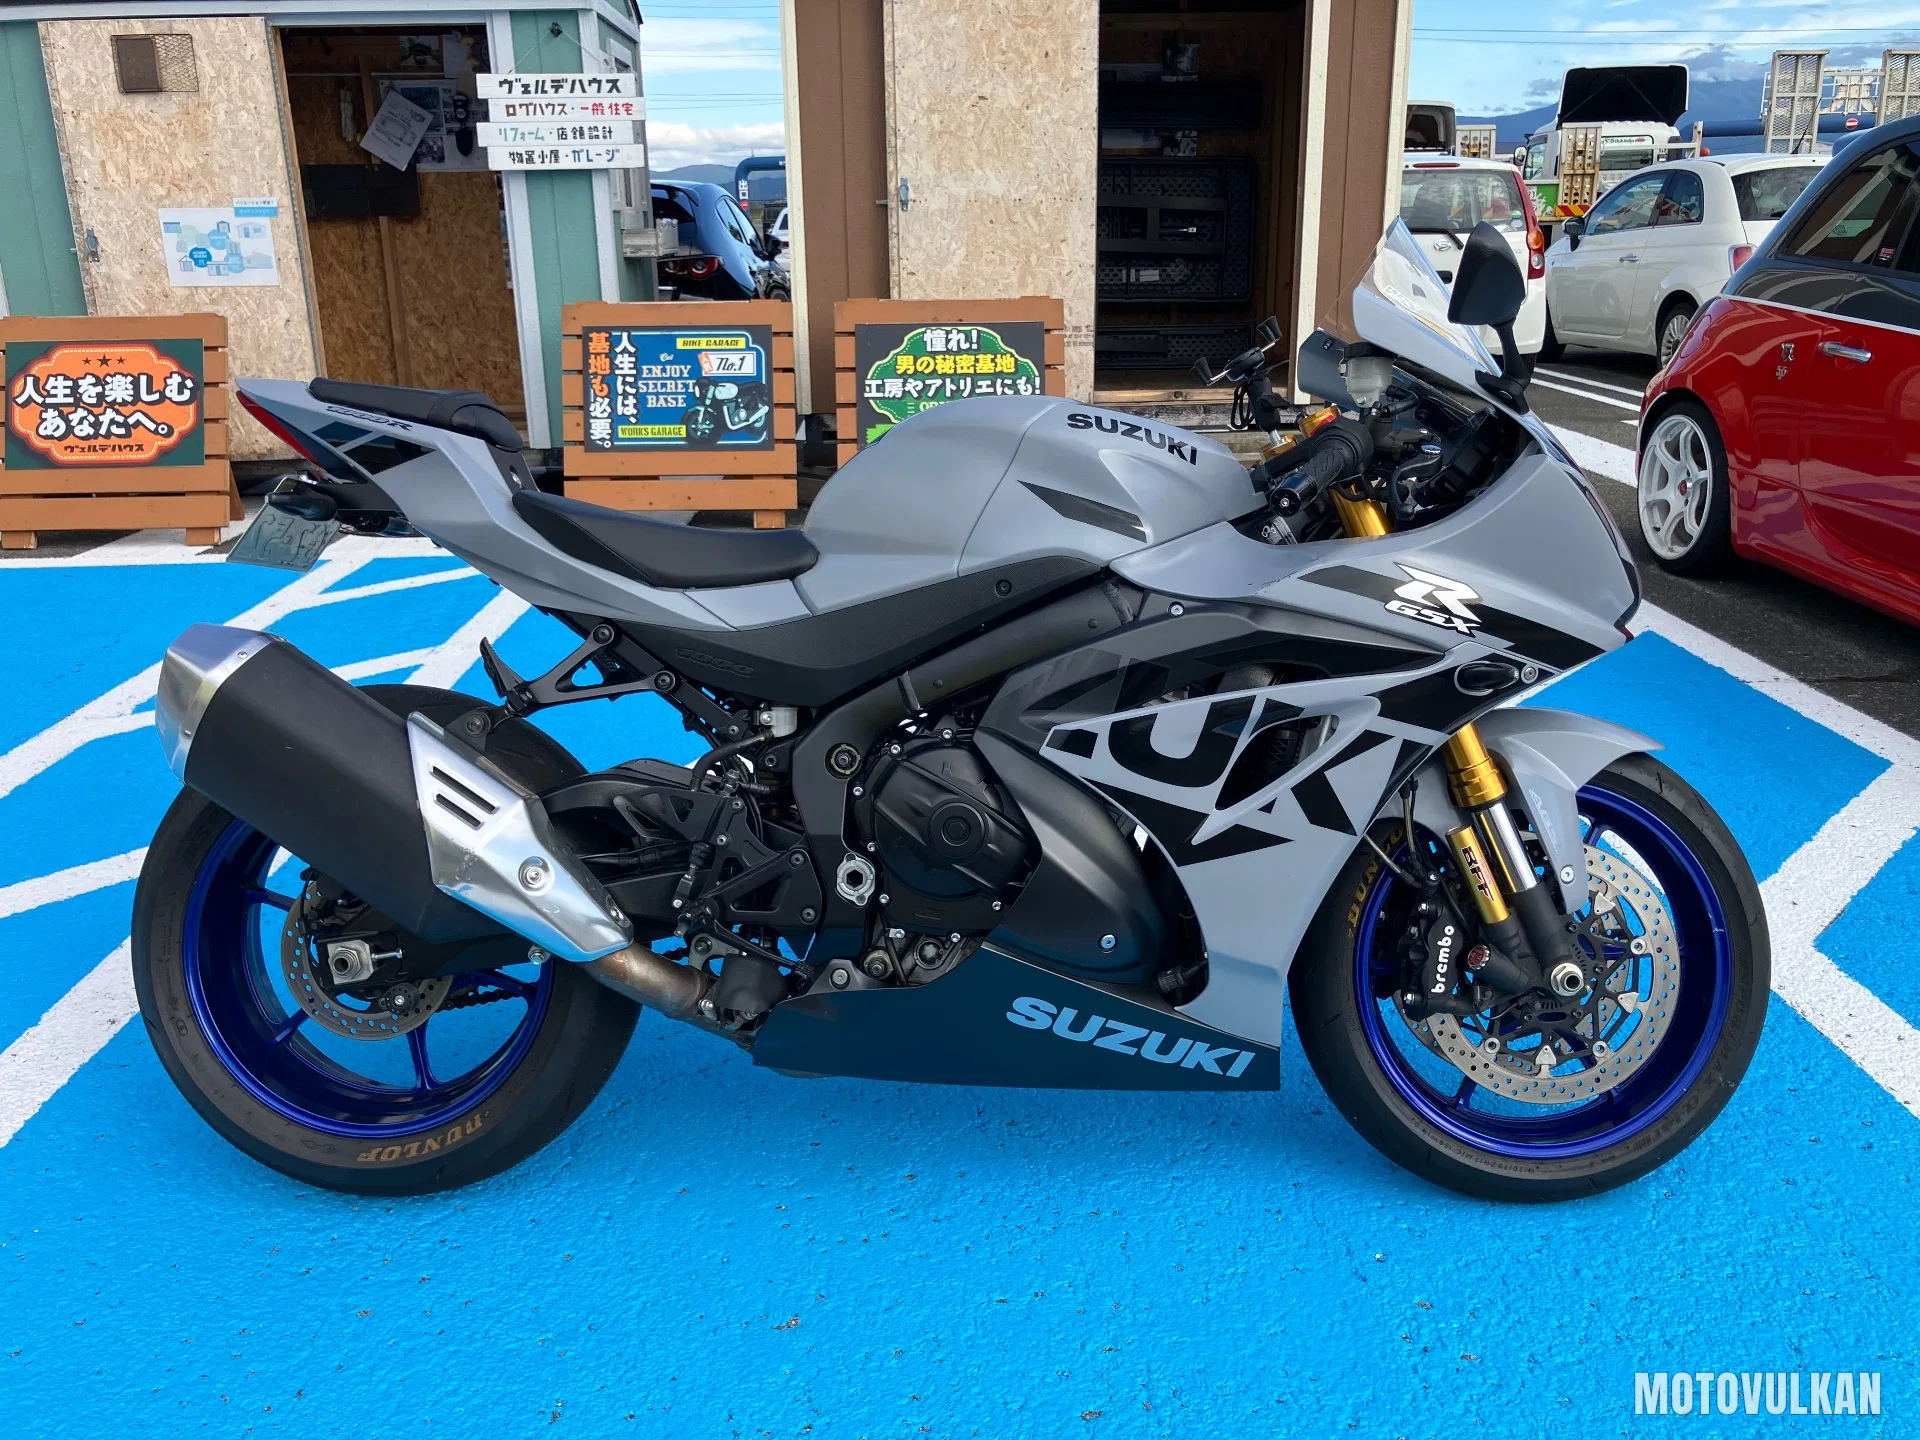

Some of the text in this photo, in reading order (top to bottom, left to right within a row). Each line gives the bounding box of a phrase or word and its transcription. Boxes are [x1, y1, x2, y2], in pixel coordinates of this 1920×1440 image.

[499, 78, 622, 94] ヴェルデハウス
[738, 179, 749, 200] 出口
[641, 365, 691, 378] ENJOY
[896, 354, 1016, 374] 男の秘密基地
[15, 373, 194, 405] 人生を楽しむ
[588, 331, 612, 449] 基地も必要。
[614, 331, 637, 424] 人生には、
[638, 380, 696, 393] SECRET
[647, 395, 687, 408] BASE
[37, 408, 168, 437] あなたへ。
[620, 426, 683, 436] WORKS GARAGE
[64, 443, 145, 453] ヴェルデハウス
[1066, 413, 1198, 466] SUZUKI
[1431, 925, 1455, 993] brembo
[1006, 996, 1256, 1078] SUZUKI
[356, 1113, 484, 1162] DUNLOP
